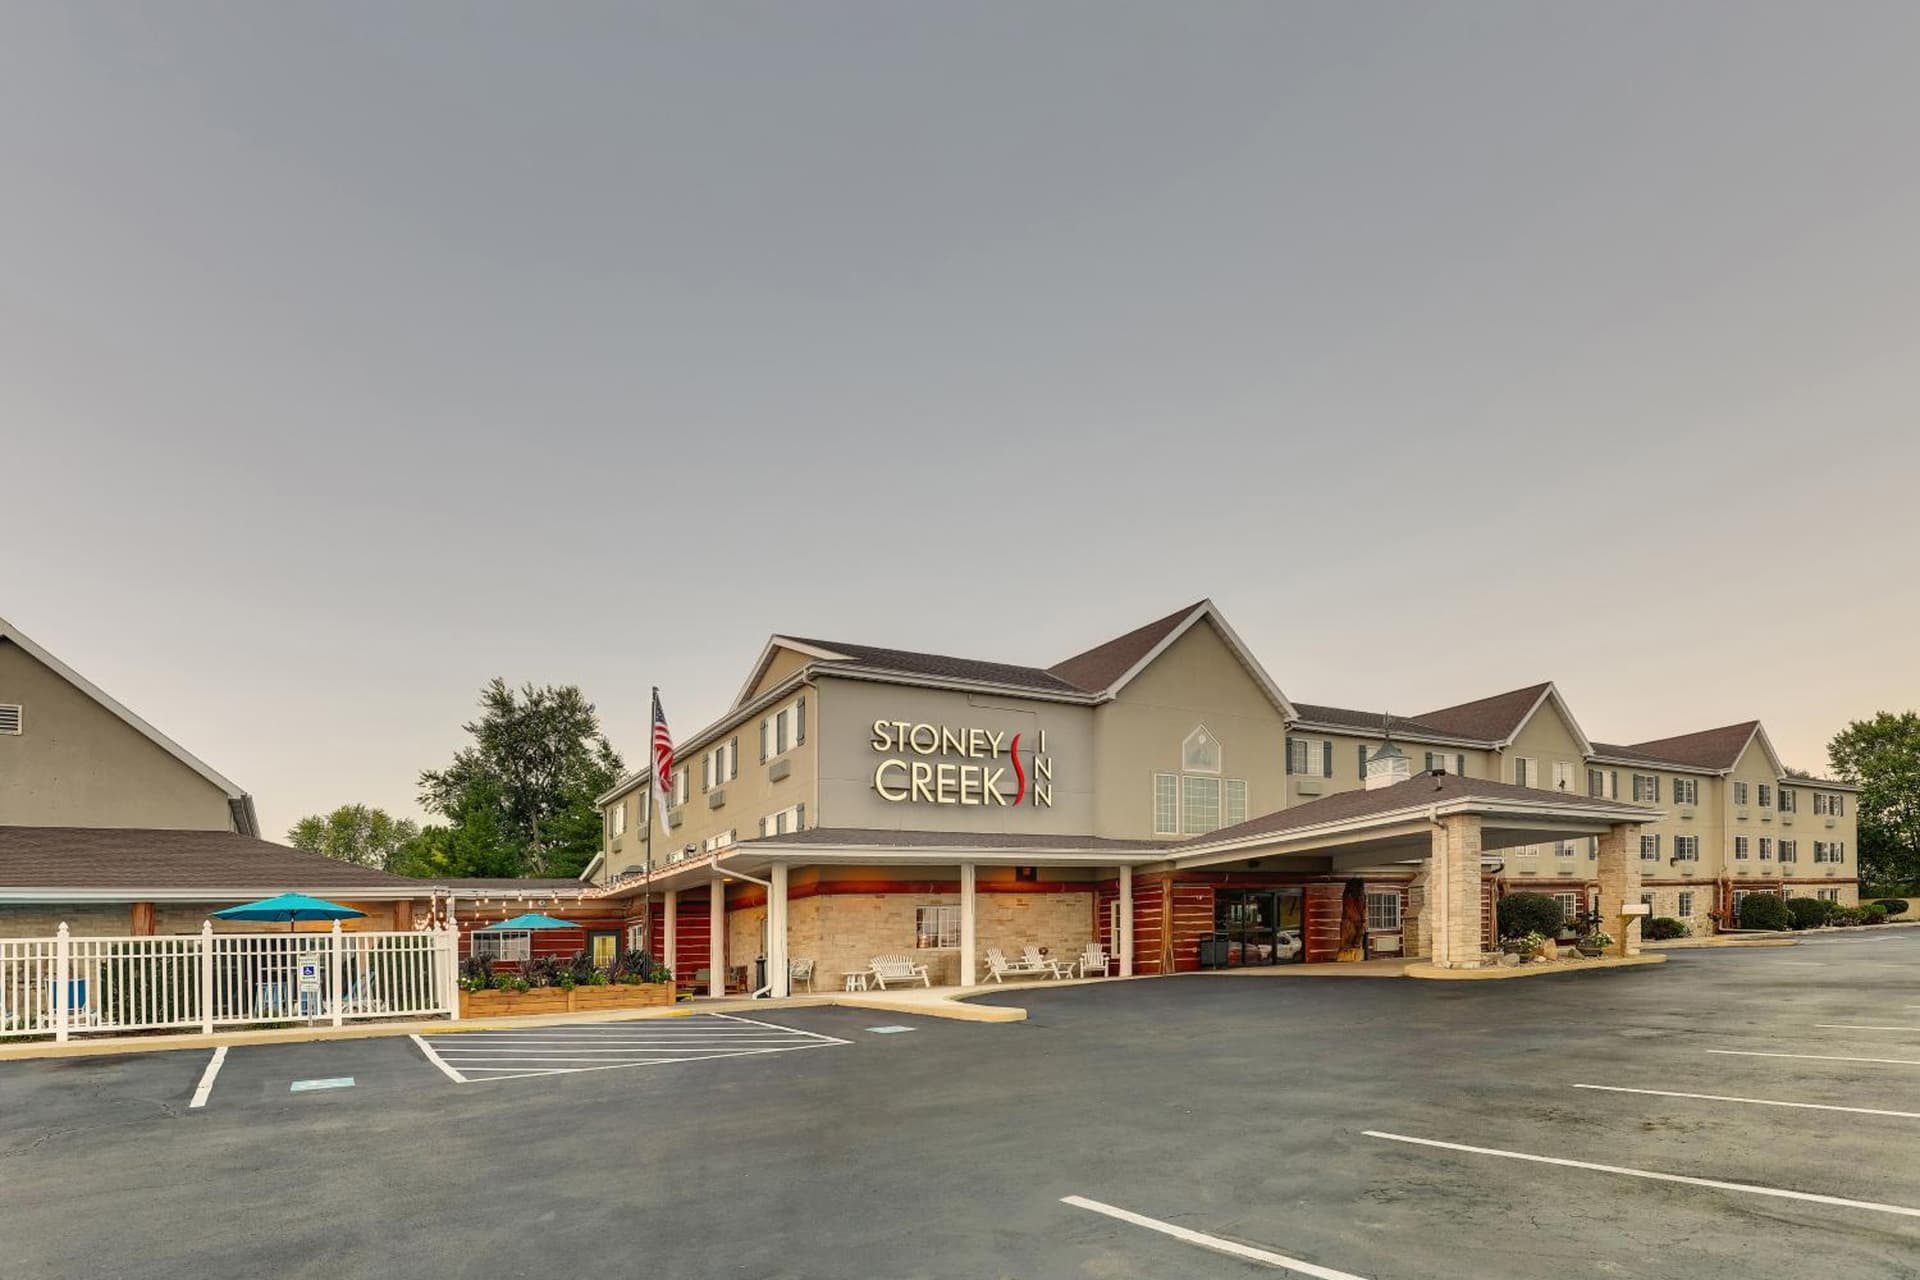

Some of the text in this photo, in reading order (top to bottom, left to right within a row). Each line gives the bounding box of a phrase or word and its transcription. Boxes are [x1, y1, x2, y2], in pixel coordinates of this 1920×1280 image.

[872, 719, 1004, 759] STONEY
[875, 759, 1006, 806] CREEK
[1034, 729, 1051, 807] INN
